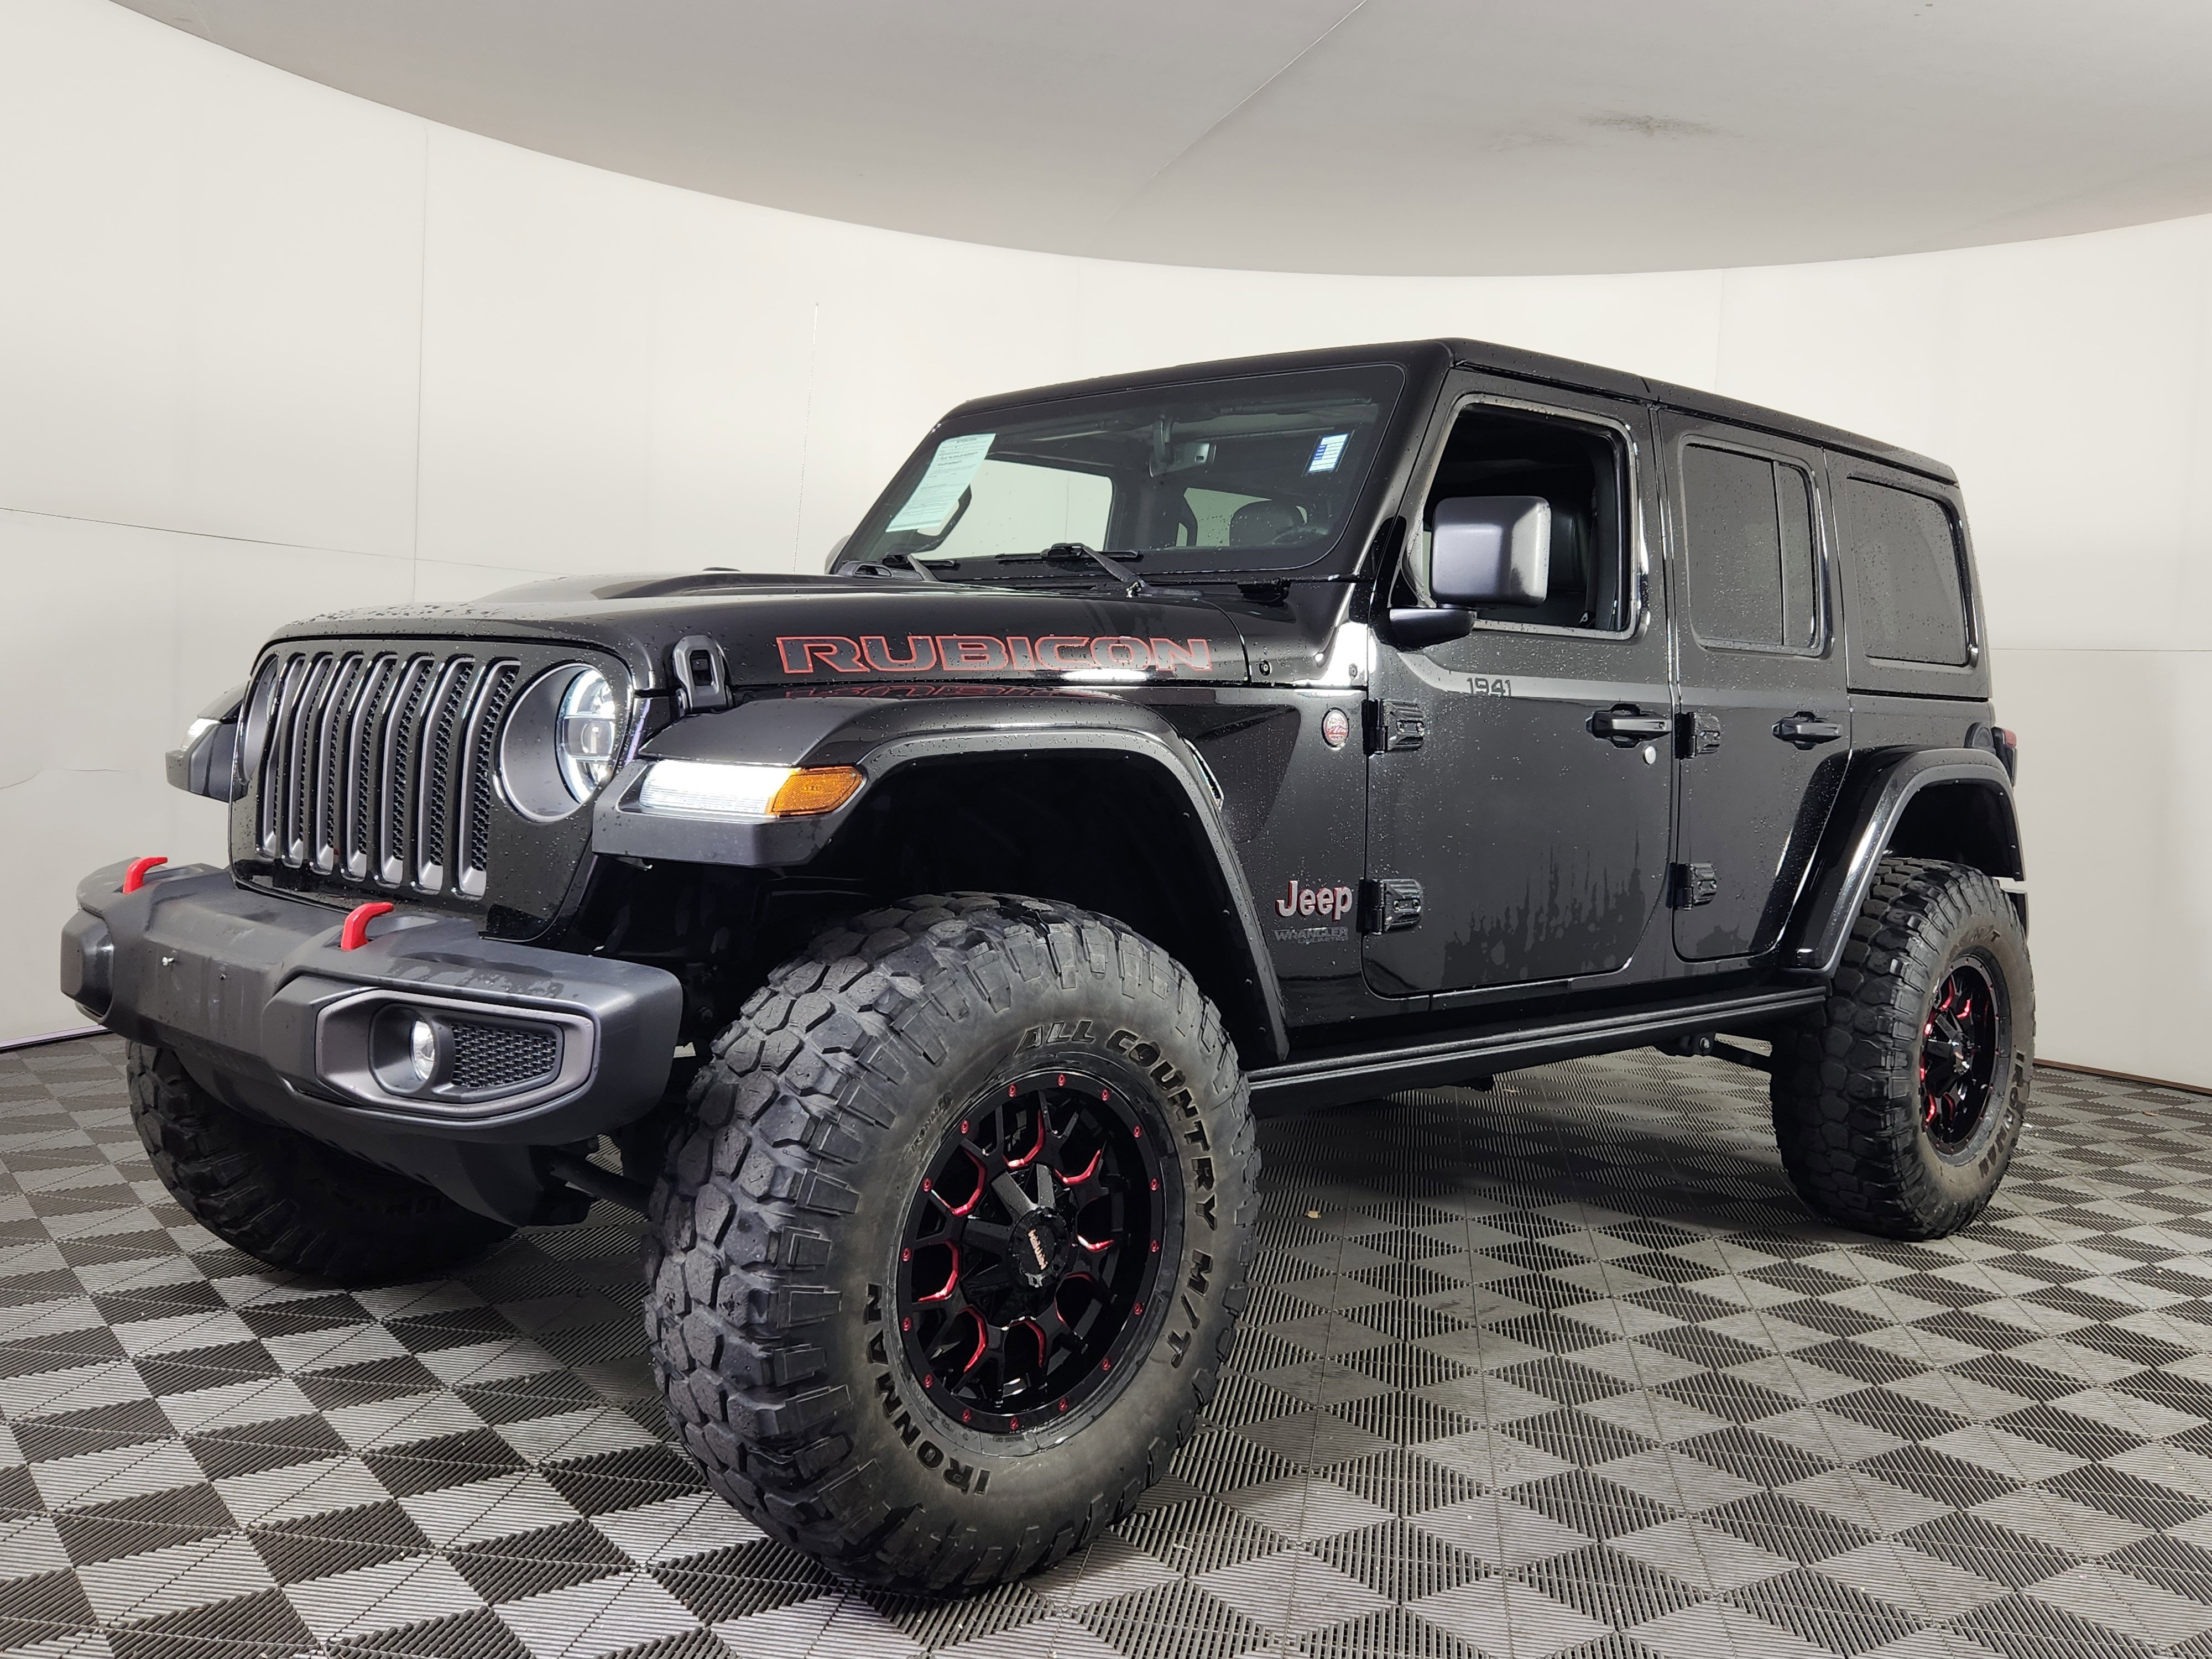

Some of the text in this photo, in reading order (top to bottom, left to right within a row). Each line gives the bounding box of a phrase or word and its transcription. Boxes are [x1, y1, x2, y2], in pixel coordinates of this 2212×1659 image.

[776, 635, 1213, 674] RUBICON
[1467, 677, 1511, 697] 1941
[1275, 880, 1353, 921] Jeep
[1014, 1020, 1217, 1369] ALL COUNTRY M/T
[863, 1283, 990, 1494] IRONMAN
